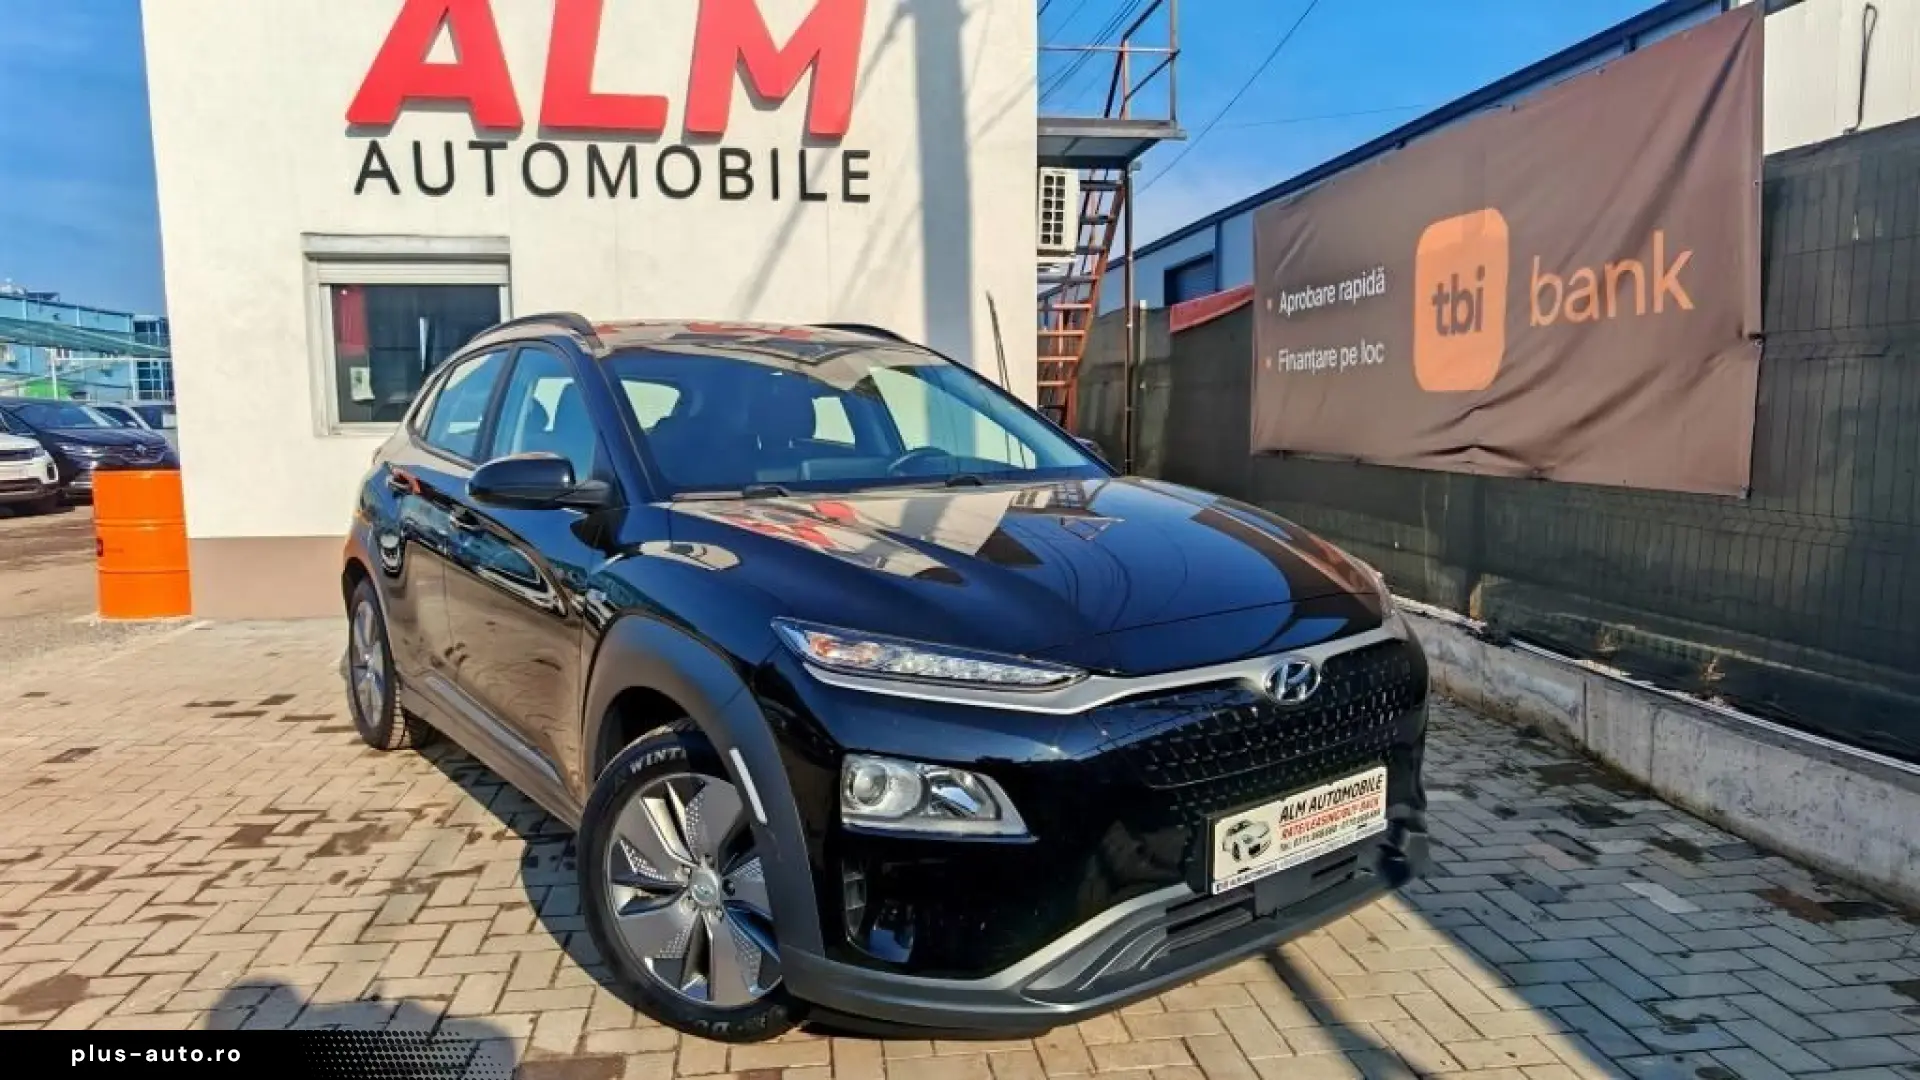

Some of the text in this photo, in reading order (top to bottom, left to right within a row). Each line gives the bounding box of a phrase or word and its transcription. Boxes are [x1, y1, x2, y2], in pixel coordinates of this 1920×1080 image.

[345, 0, 868, 135] ALM
[354, 139, 871, 203] AUTOMOBILE
[1279, 265, 1386, 318] Aprobare rapidă
[1432, 229, 1695, 336] tbi bank
[1278, 338, 1386, 375] Finanțare pe loc
[1279, 800, 1307, 824] ALM
[1309, 773, 1384, 813] AUTOMOBILE
